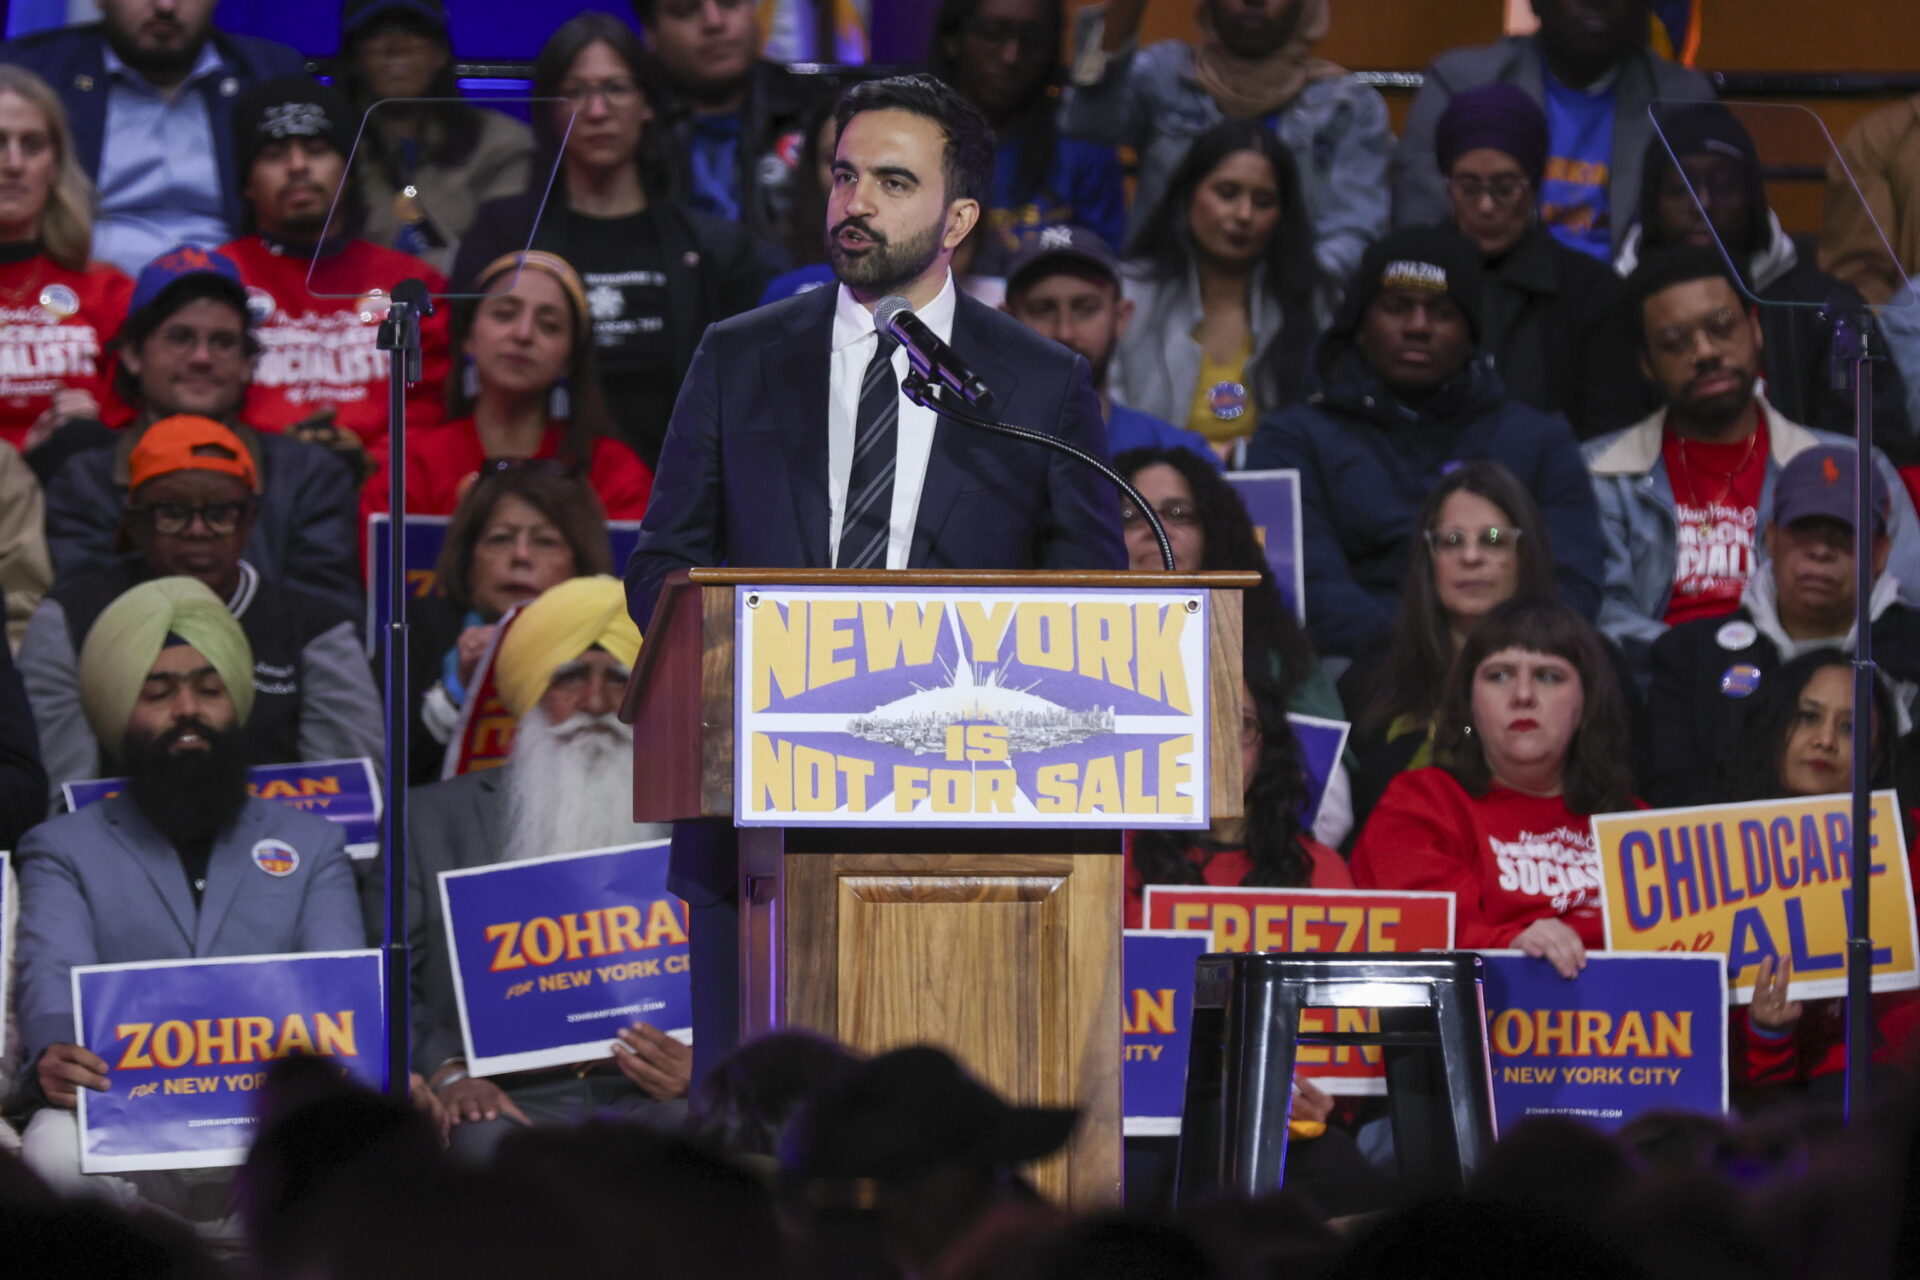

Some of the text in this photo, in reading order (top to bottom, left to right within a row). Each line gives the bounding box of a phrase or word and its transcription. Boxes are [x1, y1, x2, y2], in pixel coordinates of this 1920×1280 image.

[752, 600, 1193, 715] NEW YORK
[946, 725, 1009, 762] IS
[752, 731, 1194, 813] NOT FOR SALE
[484, 899, 689, 973] ZOHRA
[539, 969, 592, 992] NEW
[597, 960, 662, 983] YORK
[115, 1011, 358, 1070] ZOHRAN
[1125, 1045, 1164, 1062] ITY
[1487, 1008, 1693, 1058] OHRAN
[164, 1077, 219, 1095] NEW
[224, 1072, 266, 1093] YOR
[1504, 1067, 1682, 1085] NEW YORK CITY
